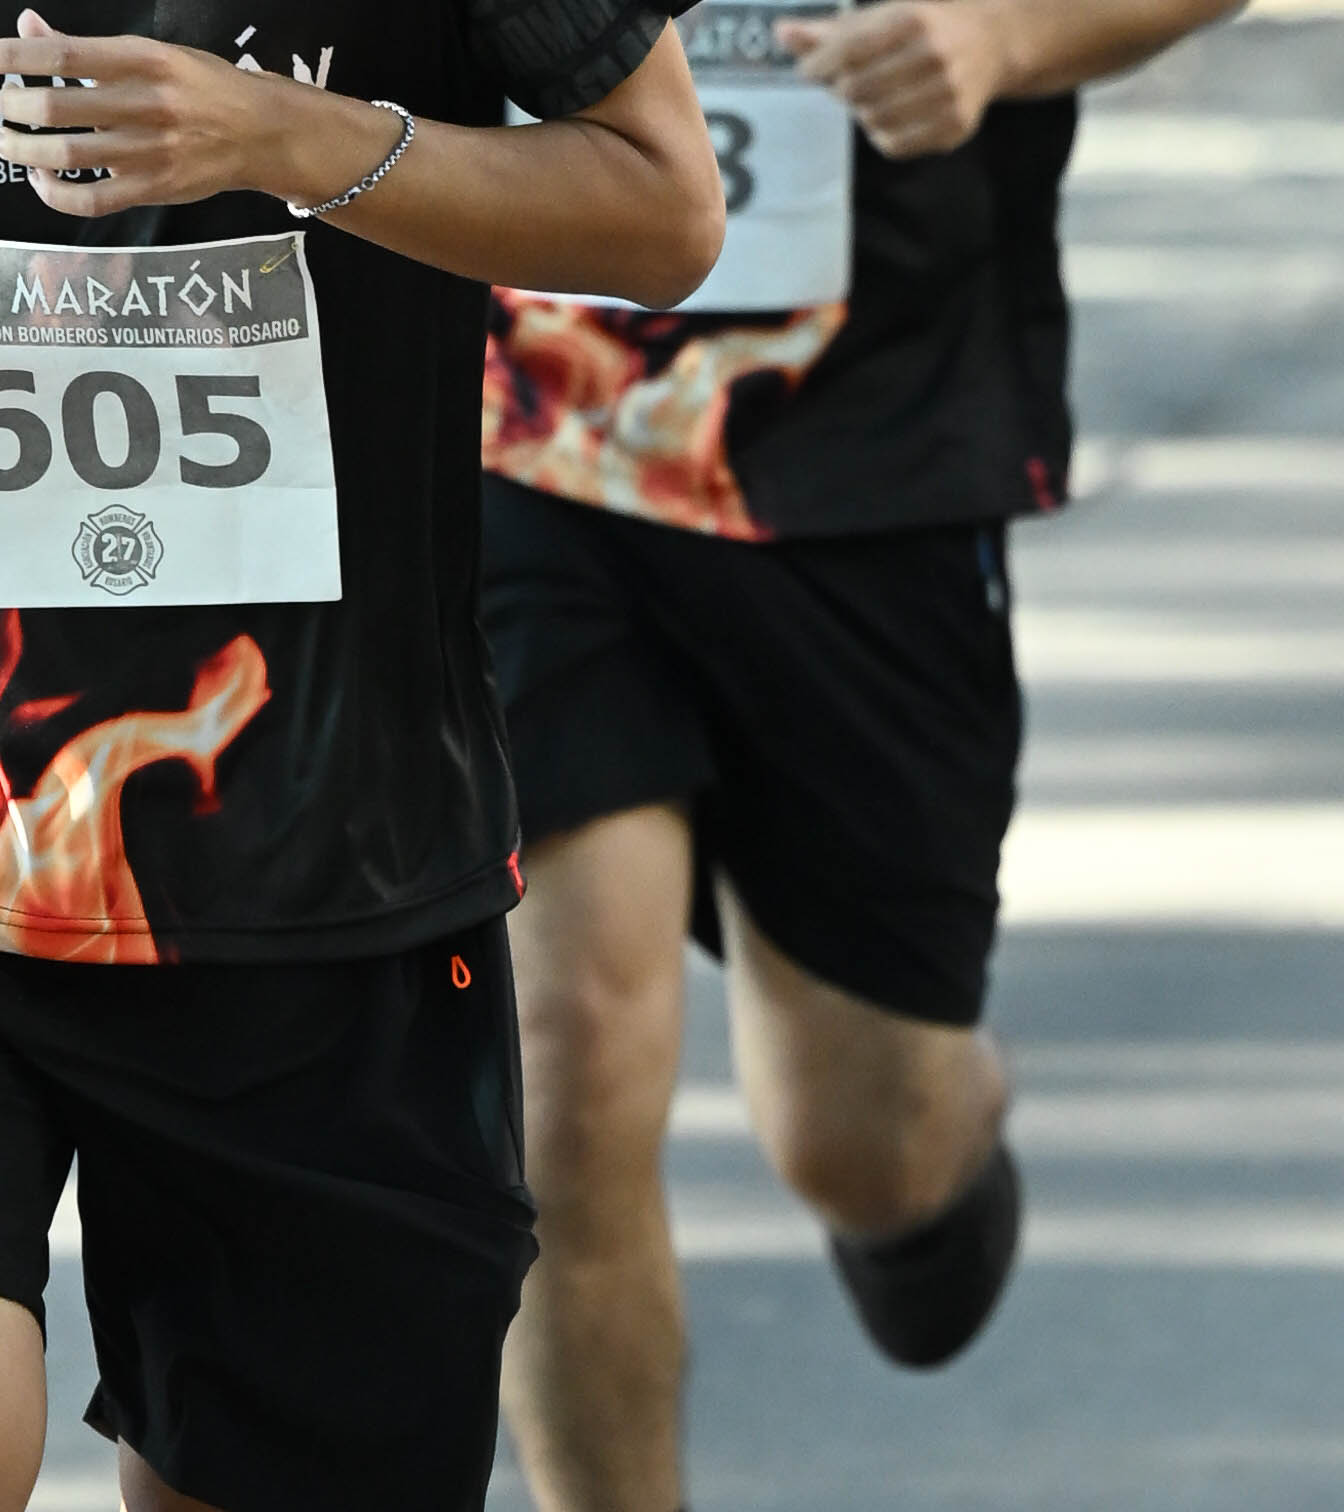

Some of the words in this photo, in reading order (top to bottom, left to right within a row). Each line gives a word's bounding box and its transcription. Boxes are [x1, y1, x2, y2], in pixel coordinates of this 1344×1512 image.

[10, 259, 254, 317] MARATÓN
[17, 325, 108, 345] BOMBEROS
[111, 325, 225, 346] VOLUNTARIOS
[228, 318, 300, 345] ROSARIO
[101, 533, 136, 564] 27
